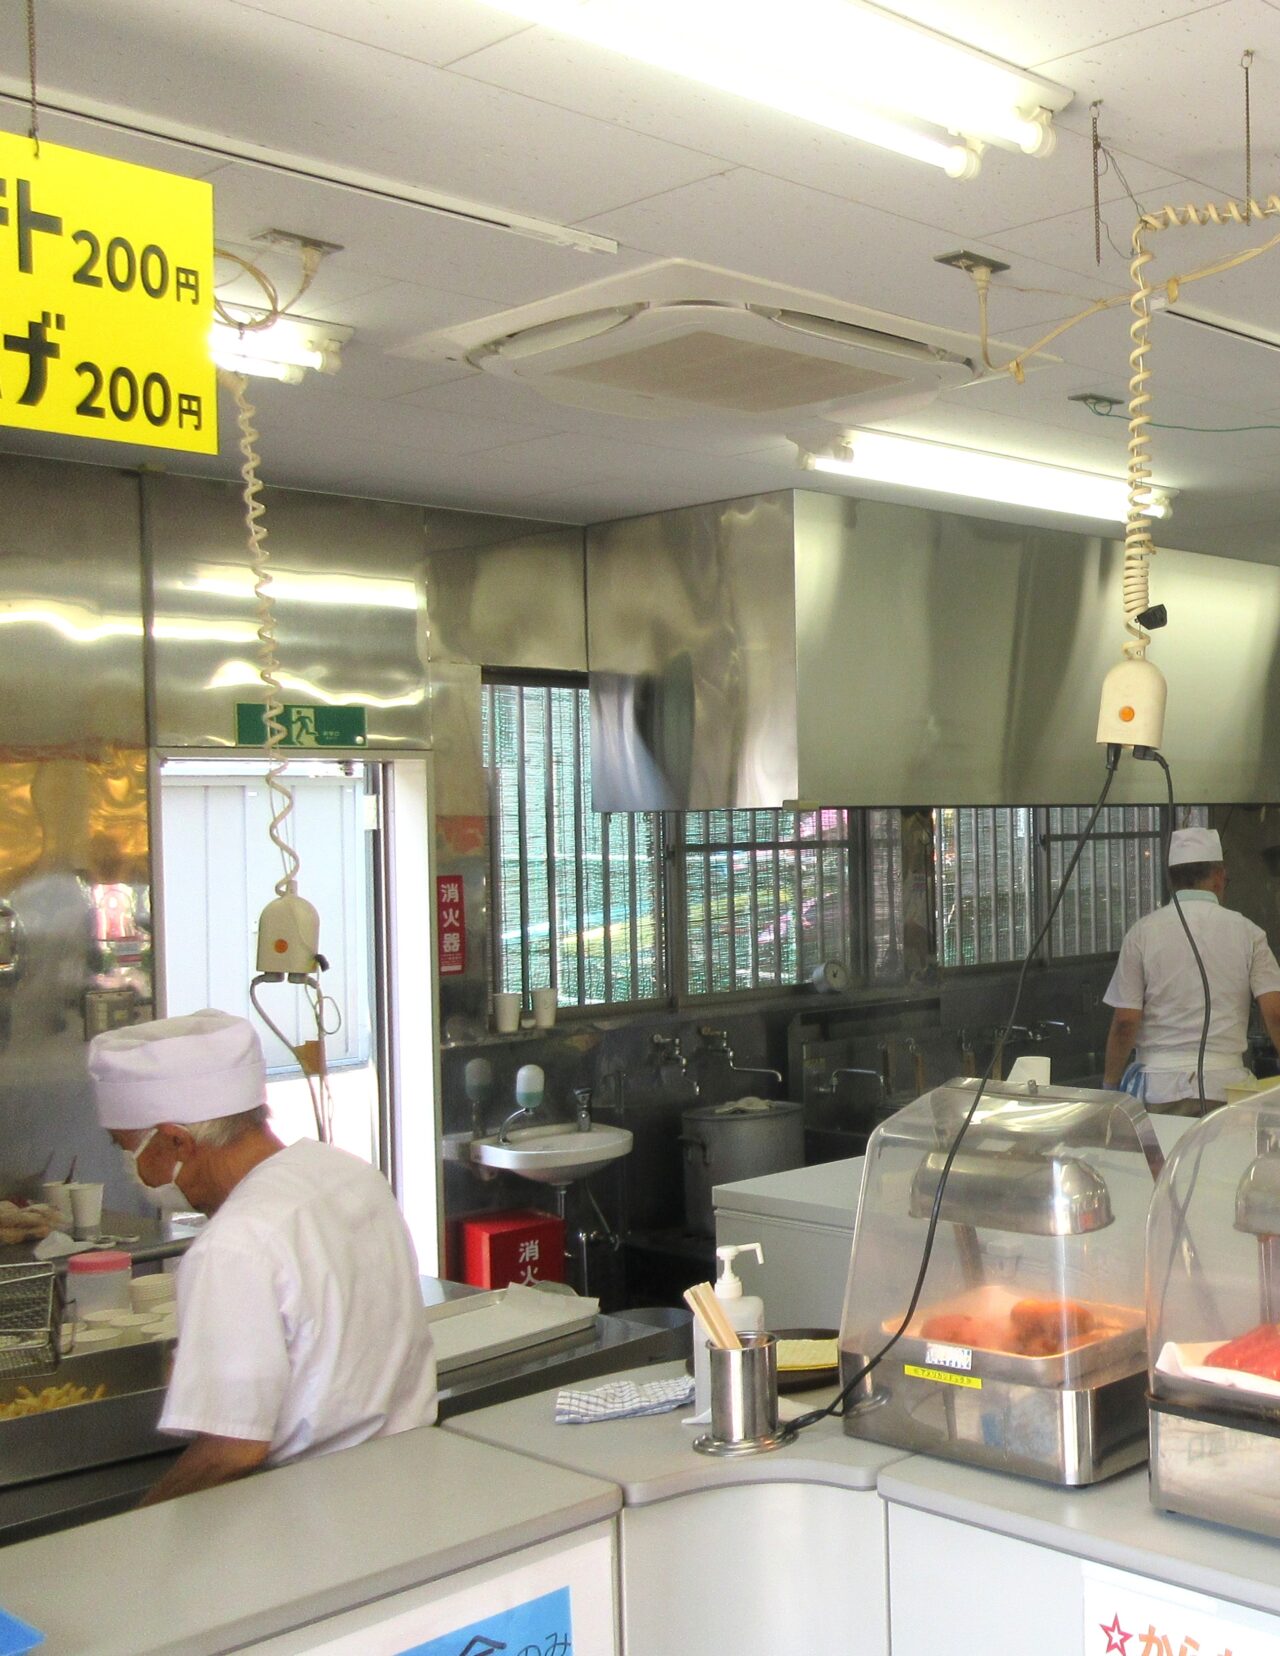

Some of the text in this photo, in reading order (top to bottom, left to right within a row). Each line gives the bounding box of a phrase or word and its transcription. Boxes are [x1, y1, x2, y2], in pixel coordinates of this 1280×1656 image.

[0, 177, 199, 305] ト 200円
[75, 361, 202, 431] 200円
[441, 883, 460, 952] 消火器
